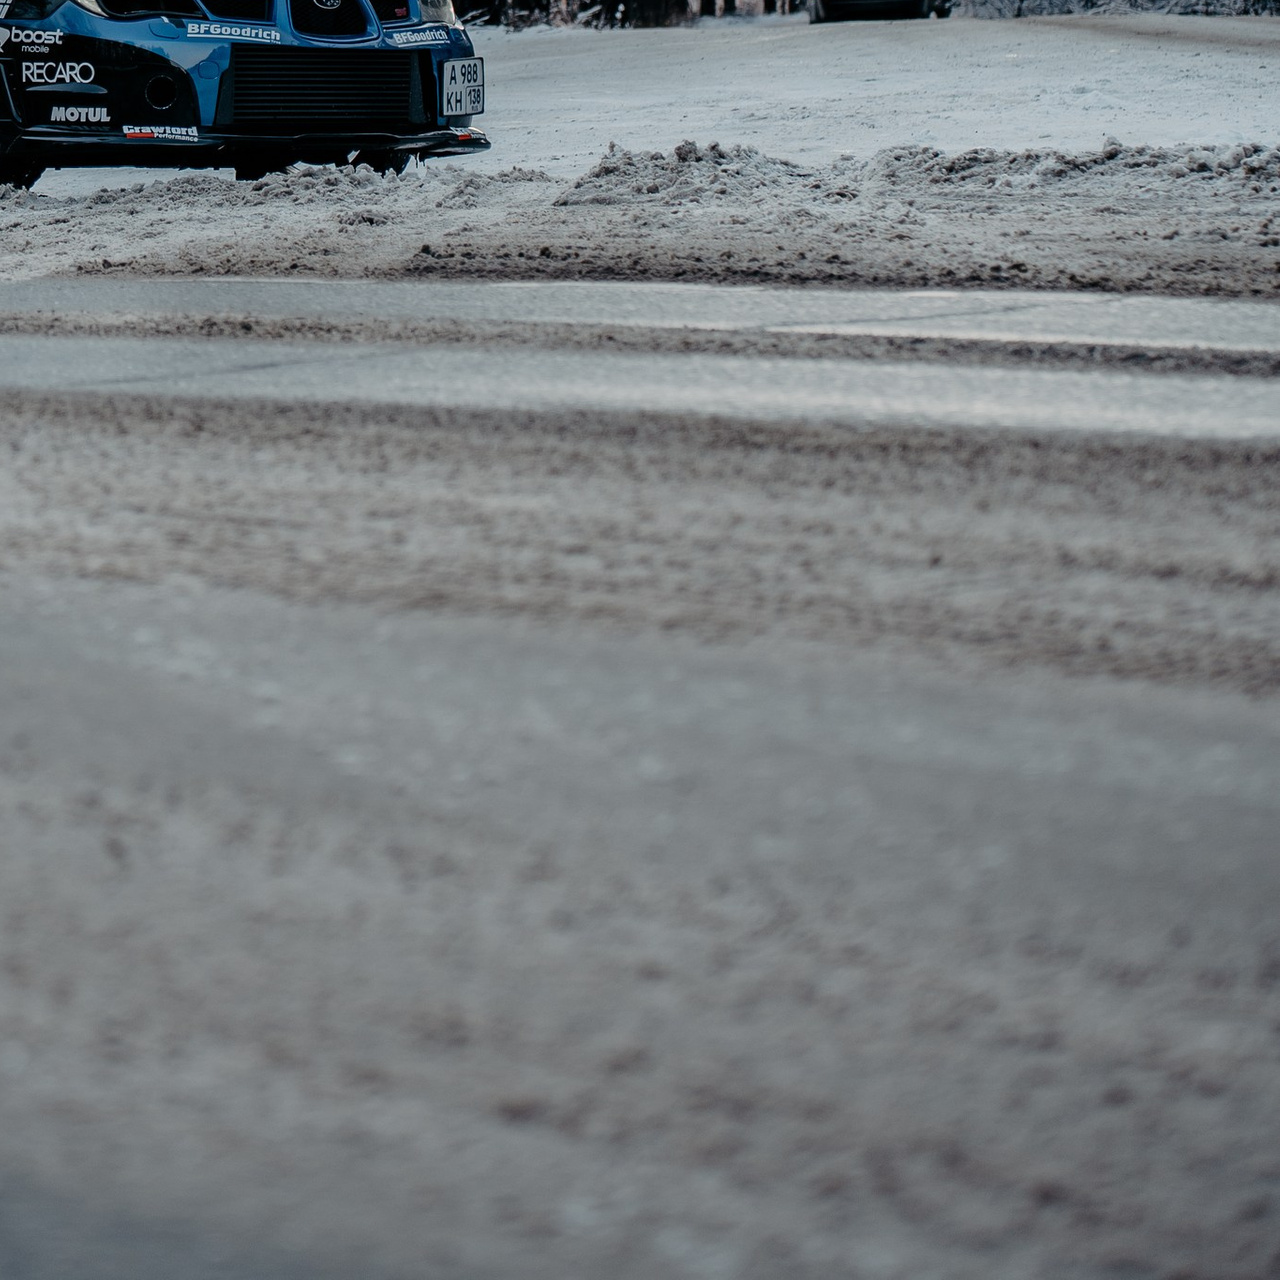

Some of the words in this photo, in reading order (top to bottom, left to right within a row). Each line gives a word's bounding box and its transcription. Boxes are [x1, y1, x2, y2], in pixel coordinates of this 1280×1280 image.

[11, 26, 64, 44] boost
[187, 23, 281, 40] BFGoodrich
[393, 29, 448, 44] BFGoodrich
[22, 45, 50, 53] mobile
[22, 62, 95, 83] RECARO
[449, 65, 457, 85] A
[461, 63, 478, 85] 988
[468, 89, 481, 105] 138
[51, 106, 111, 122] MOTUL
[122, 125, 198, 136] Crawford
[154, 132, 199, 142] Performance
